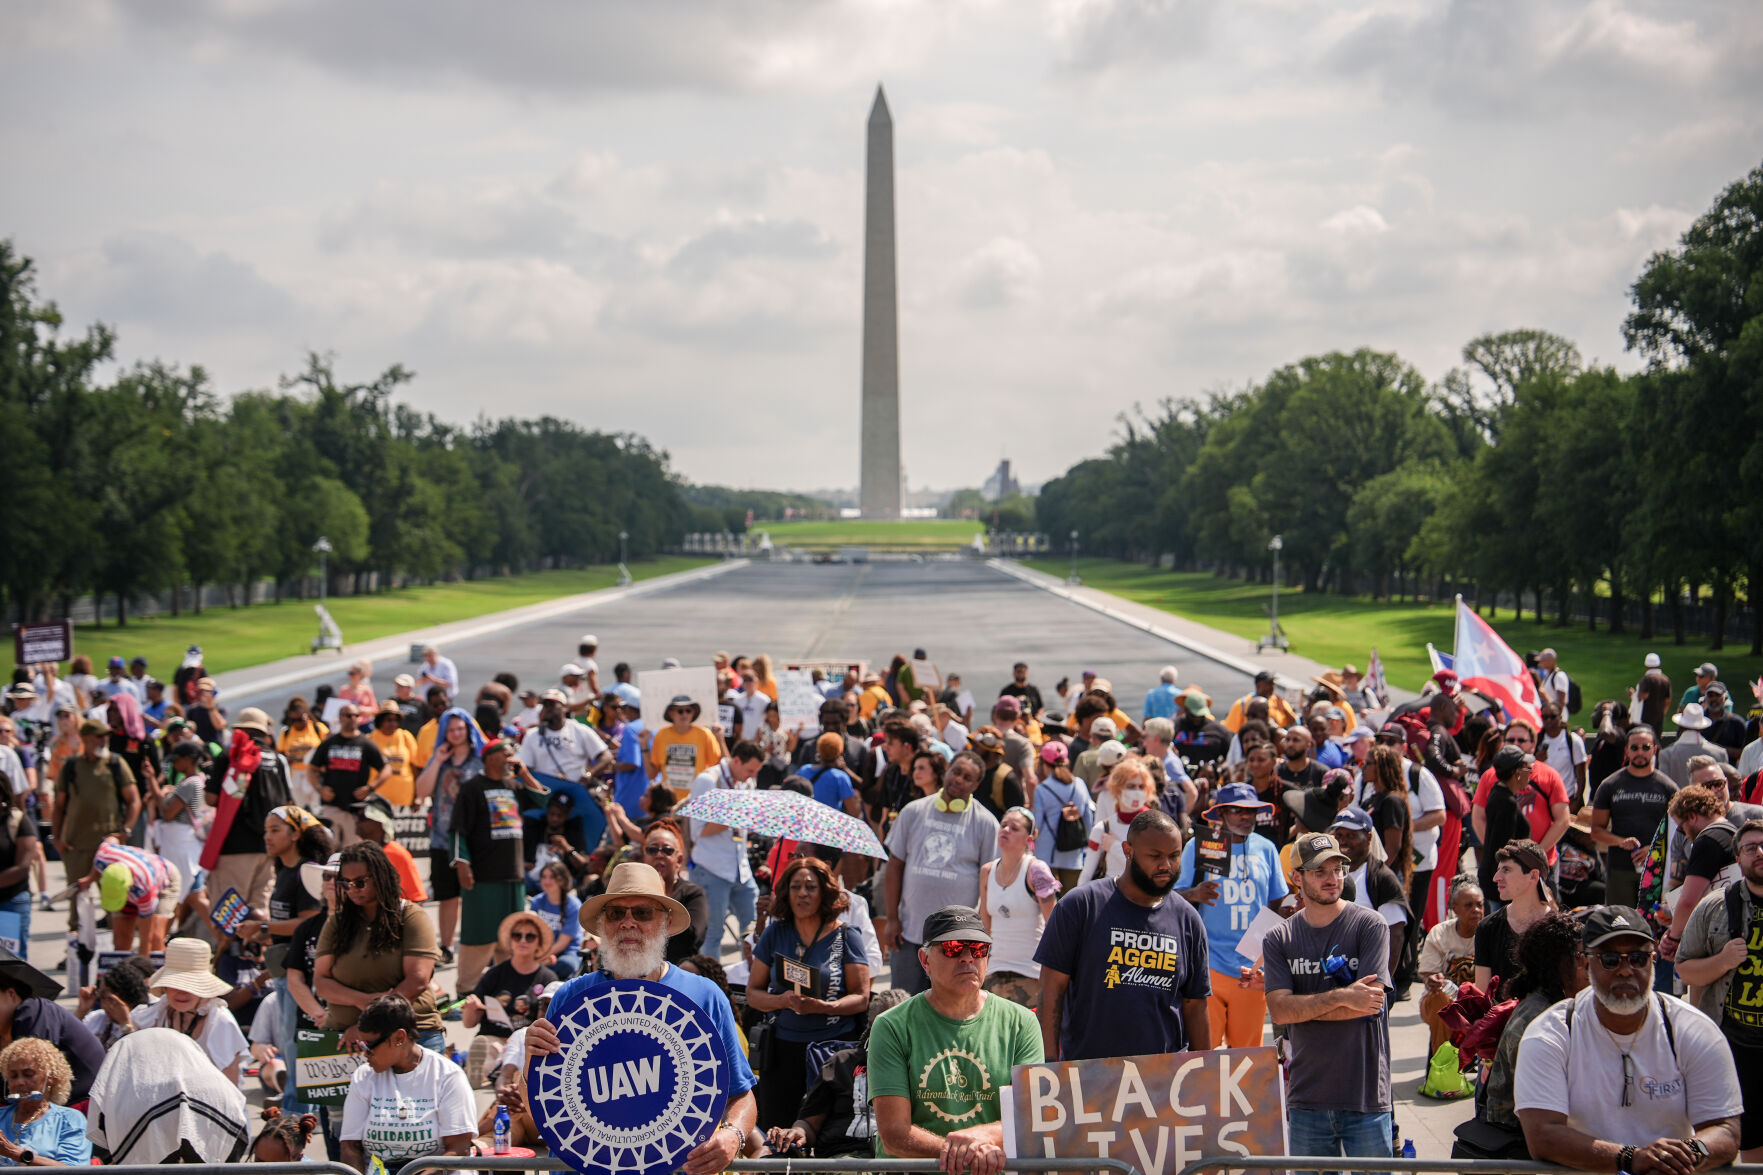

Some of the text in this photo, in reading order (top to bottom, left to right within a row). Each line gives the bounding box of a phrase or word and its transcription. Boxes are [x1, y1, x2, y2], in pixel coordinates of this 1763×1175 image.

[391, 818, 427, 833] OTES
[395, 836, 431, 851] TTER
[1209, 854, 1260, 880] UST
[1223, 879, 1257, 905] DO
[1230, 905, 1251, 930] IT
[1110, 930, 1178, 954] PROUD
[1107, 946, 1177, 972] AGGIE
[1287, 954, 1359, 975] Mitze
[1121, 966, 1175, 988] Alumni
[825, 964, 842, 1026] ARMOR
[565, 1017, 690, 1144] UNITED AUTOMOBILE, AEROSPACE AND AGRICULTURAL IMPLEMENT WORKERS OF AMERICA
[587, 1055, 662, 1104] UAW
[1652, 1079, 1681, 1095] FIRST
[307, 1085, 350, 1099] HAVE TH
[959, 1091, 974, 1103] Rail
[973, 1089, 995, 1101] Trail
[1028, 1054, 1254, 1133] BLACK
[366, 1128, 432, 1142] SOLIDARITY
